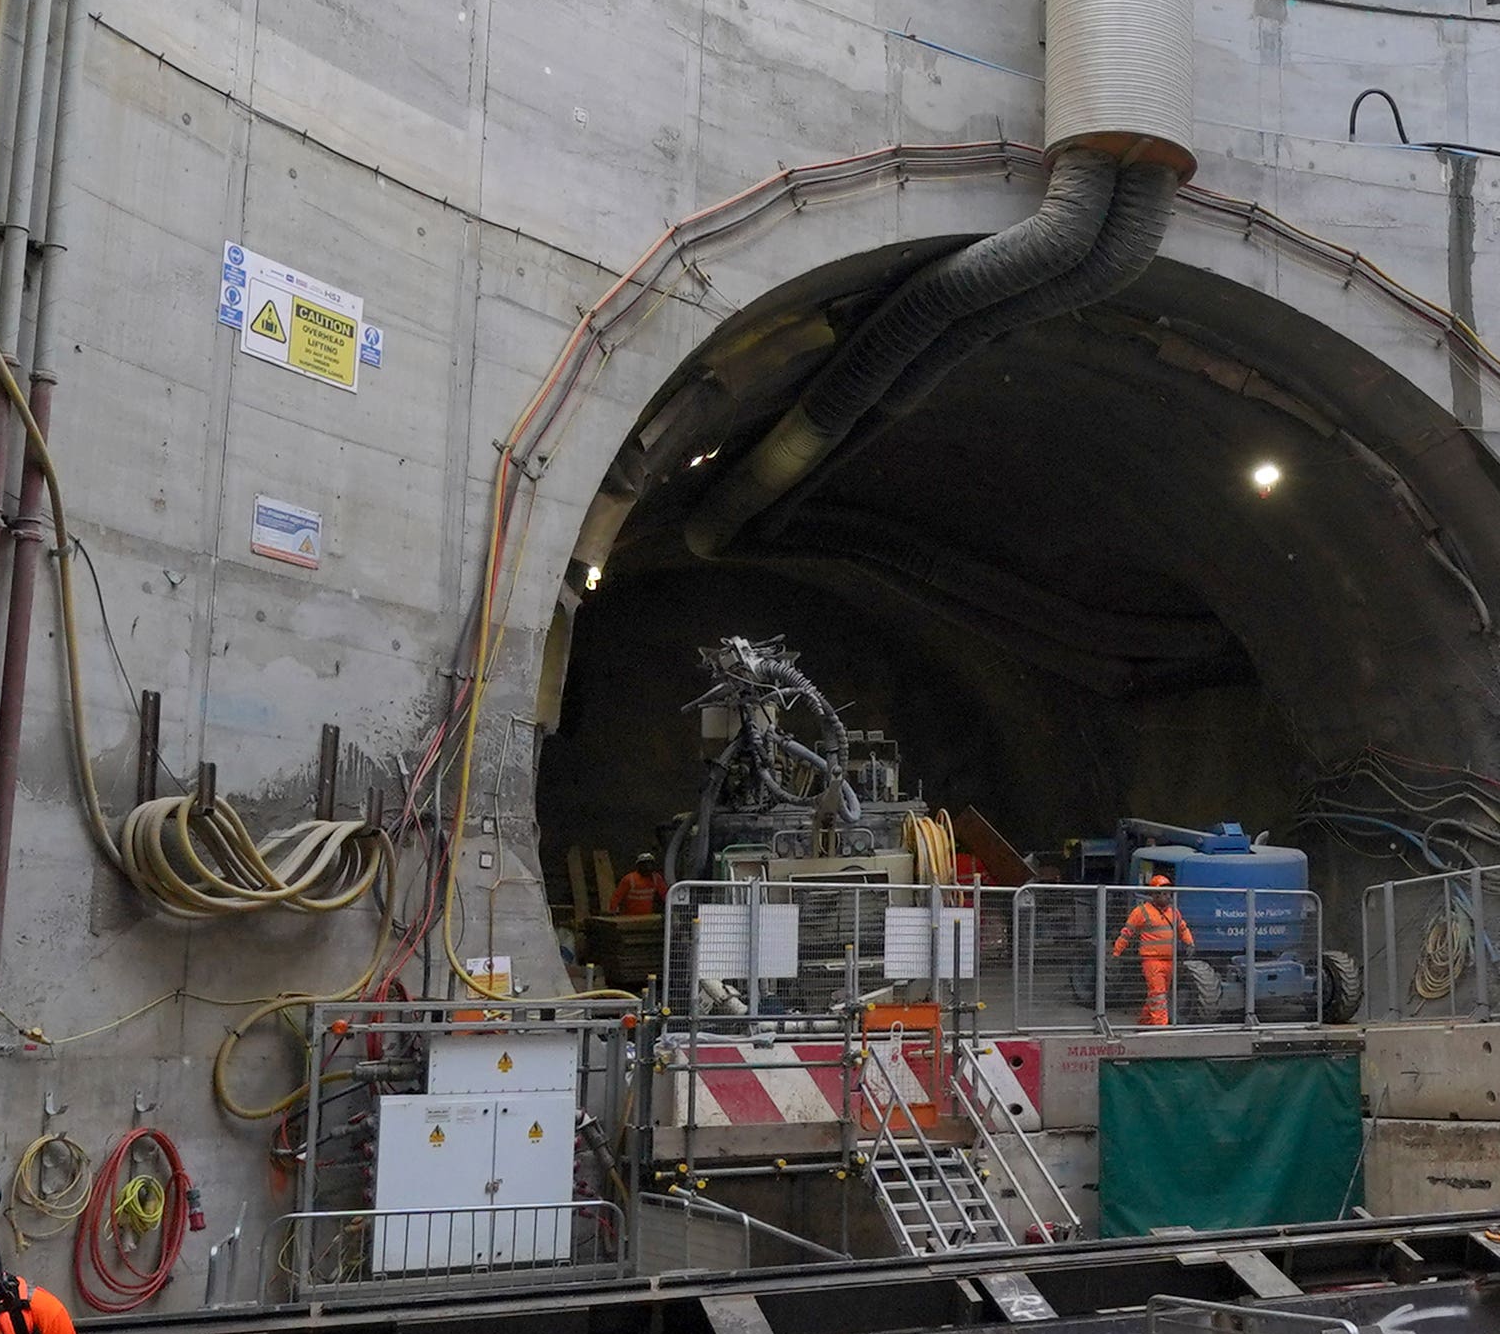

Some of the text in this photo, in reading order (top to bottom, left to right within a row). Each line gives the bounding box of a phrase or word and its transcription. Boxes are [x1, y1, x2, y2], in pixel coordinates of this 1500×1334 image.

[299, 307, 351, 337] CAUTION
[302, 325, 345, 347] OVERHEAD
[307, 339, 338, 356] LIFTING
